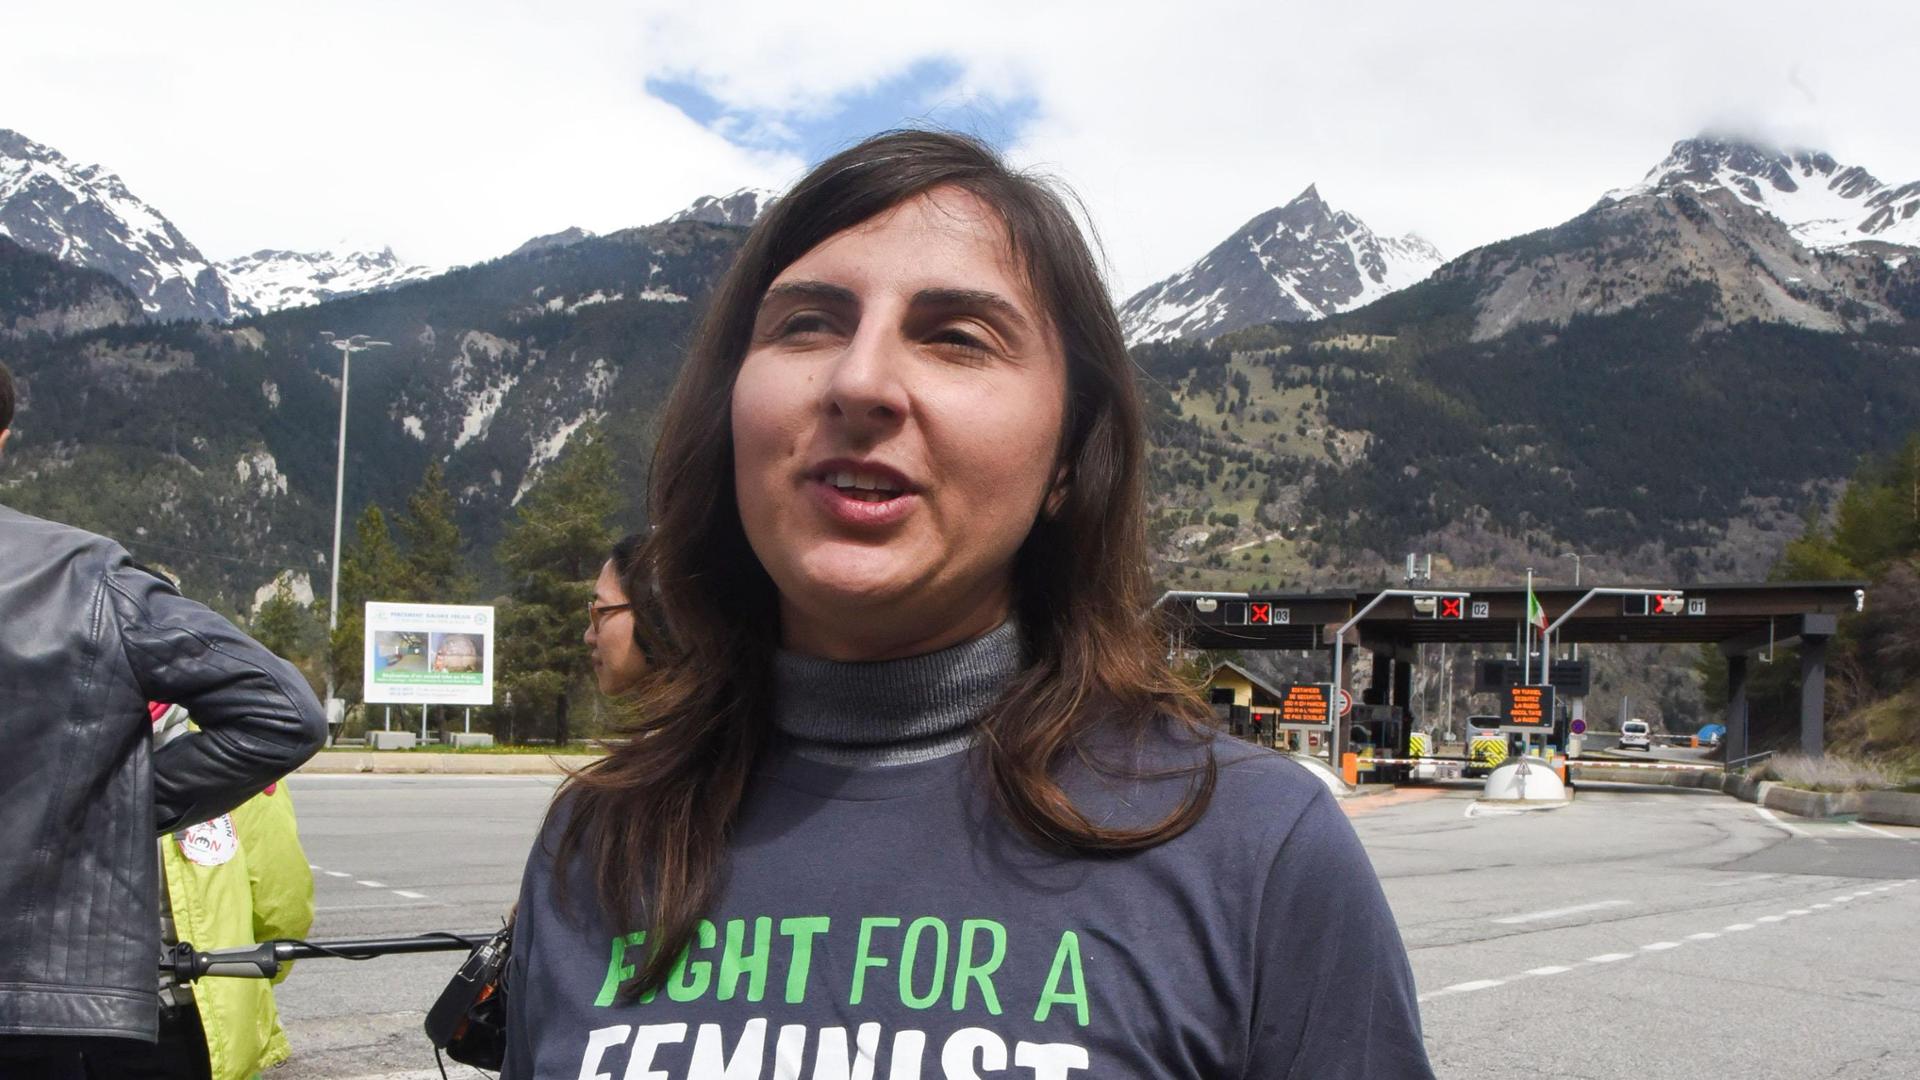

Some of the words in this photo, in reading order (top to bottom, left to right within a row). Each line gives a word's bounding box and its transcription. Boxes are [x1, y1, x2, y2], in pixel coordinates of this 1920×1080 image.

[1474, 604, 1487, 616] 02
[1691, 601, 1704, 612] 01
[1275, 610, 1288, 621] 03
[849, 916, 1007, 1015] FOR
[1034, 930, 1090, 1027] A
